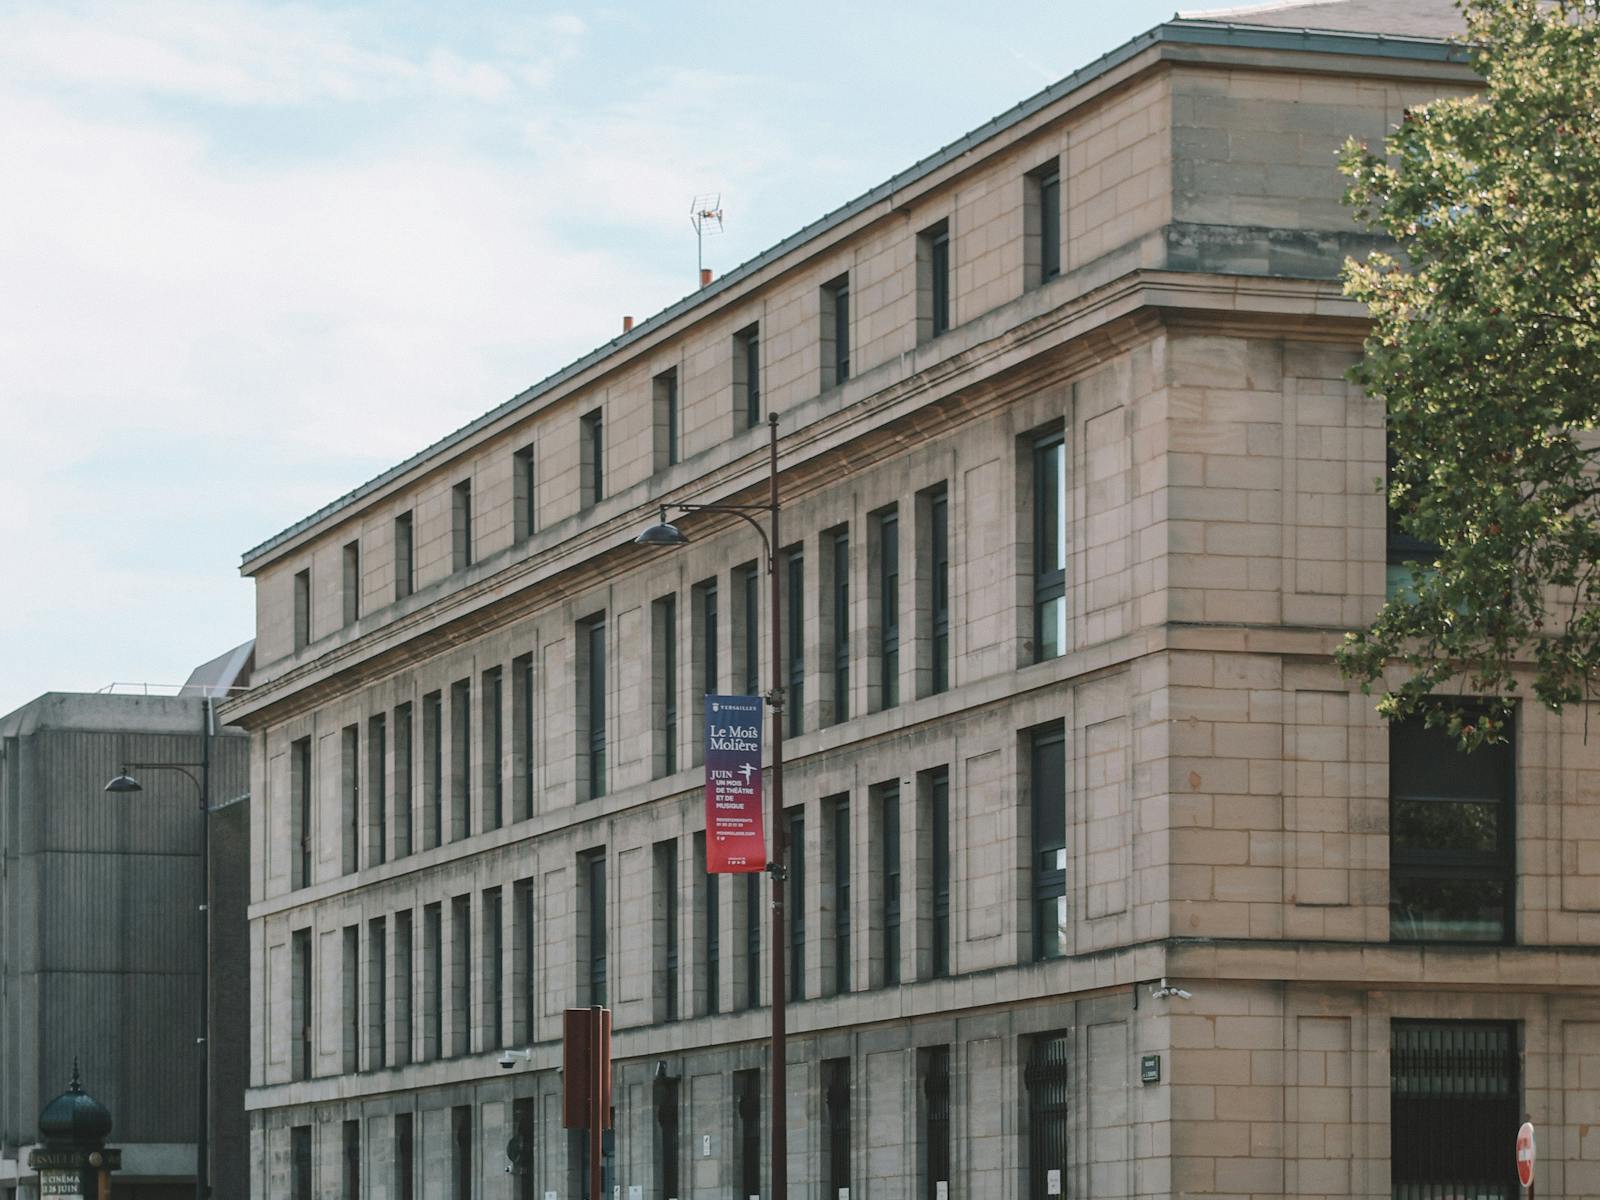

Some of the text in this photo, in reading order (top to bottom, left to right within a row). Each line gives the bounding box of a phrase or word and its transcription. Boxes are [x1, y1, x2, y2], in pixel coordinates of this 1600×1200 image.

[710, 725, 758, 738] Le Mois
[710, 738, 758, 751] Molière
[710, 770, 733, 780] JUIN
[57, 1185, 78, 1193] JUIN
